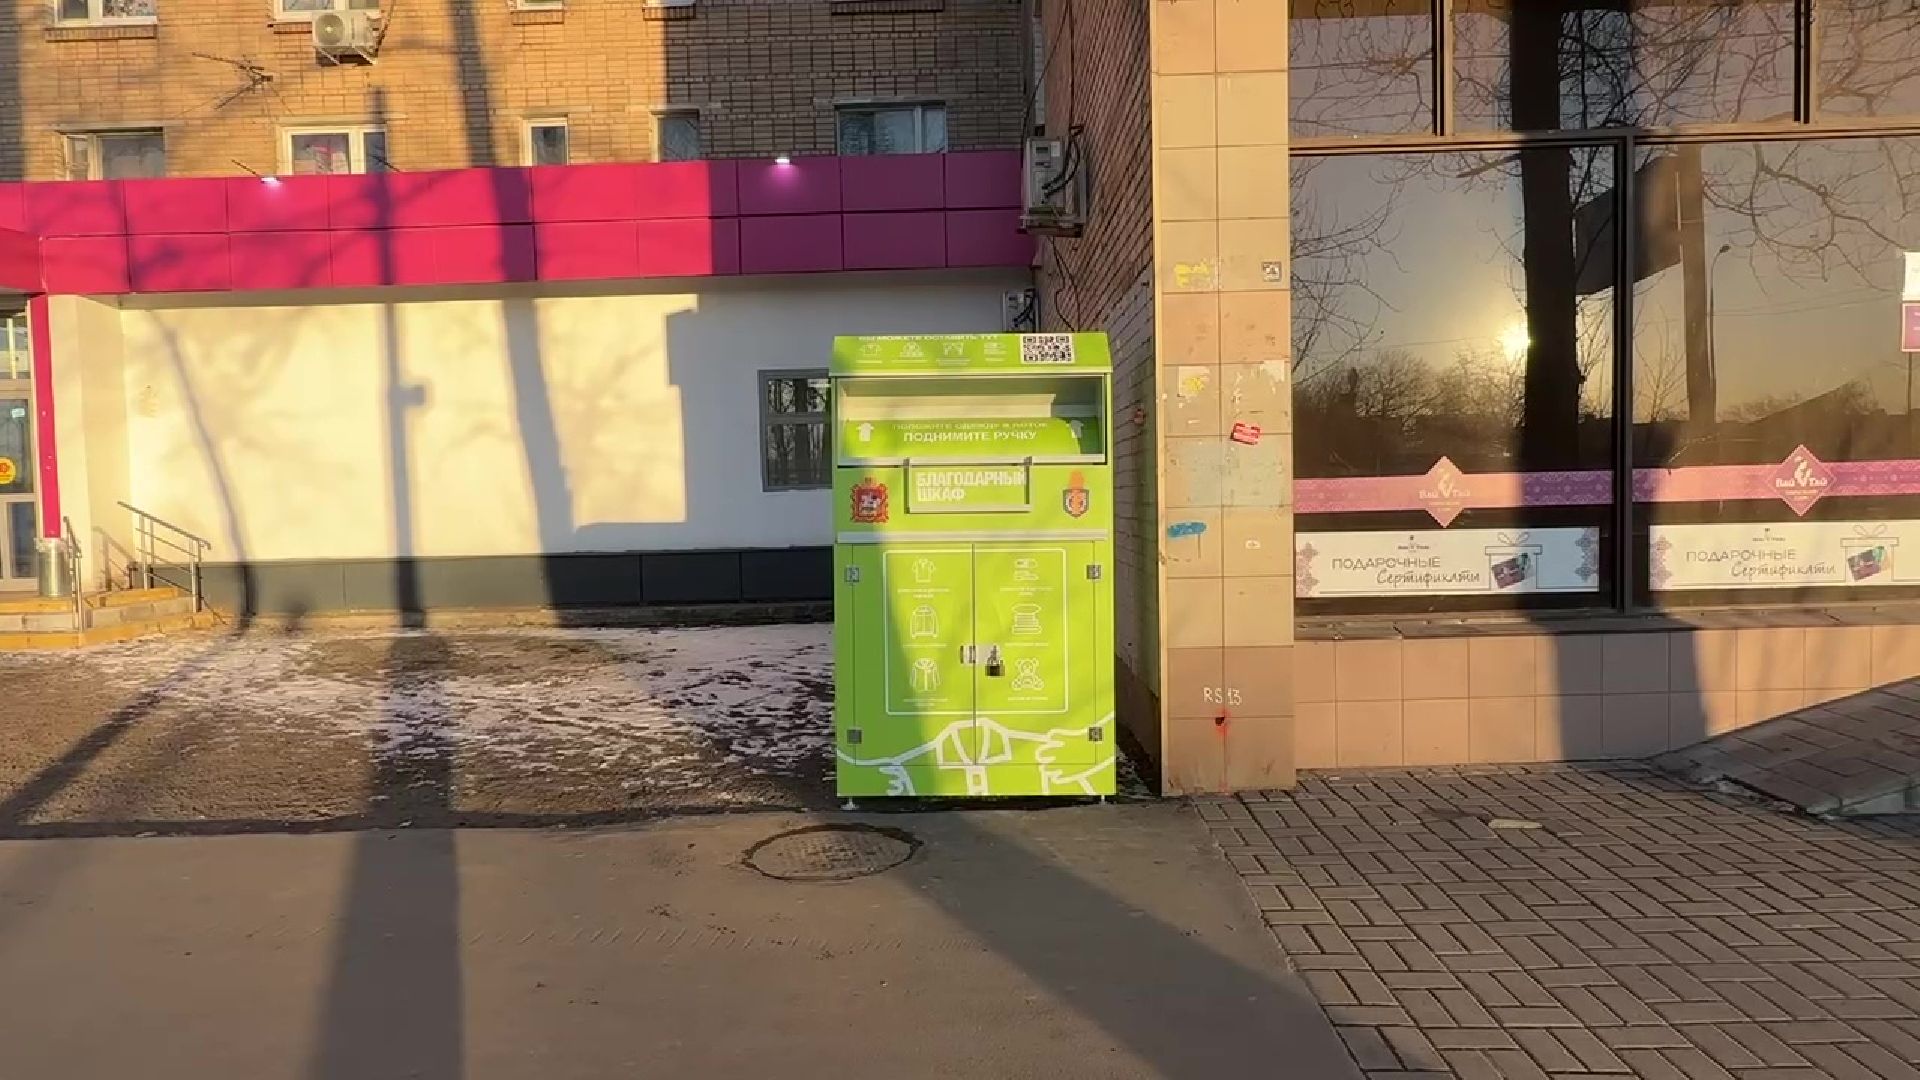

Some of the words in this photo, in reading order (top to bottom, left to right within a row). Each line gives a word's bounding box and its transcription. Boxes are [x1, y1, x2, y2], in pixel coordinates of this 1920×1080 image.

[903, 431, 992, 443] ПОДНИМИТЕ
[993, 430, 1037, 441] РУЧКУ
[916, 468, 1026, 487] БЛАГОДАРНЫЙ
[917, 486, 967, 503] ШКАФ
[1331, 555, 1441, 571] ПОДАРОЧНЫЕ
[1685, 548, 1797, 563] ПОДАРОЧНЫЕ
[1376, 568, 1480, 588] Сертификаты
[1731, 561, 1836, 580] Сертификаты
